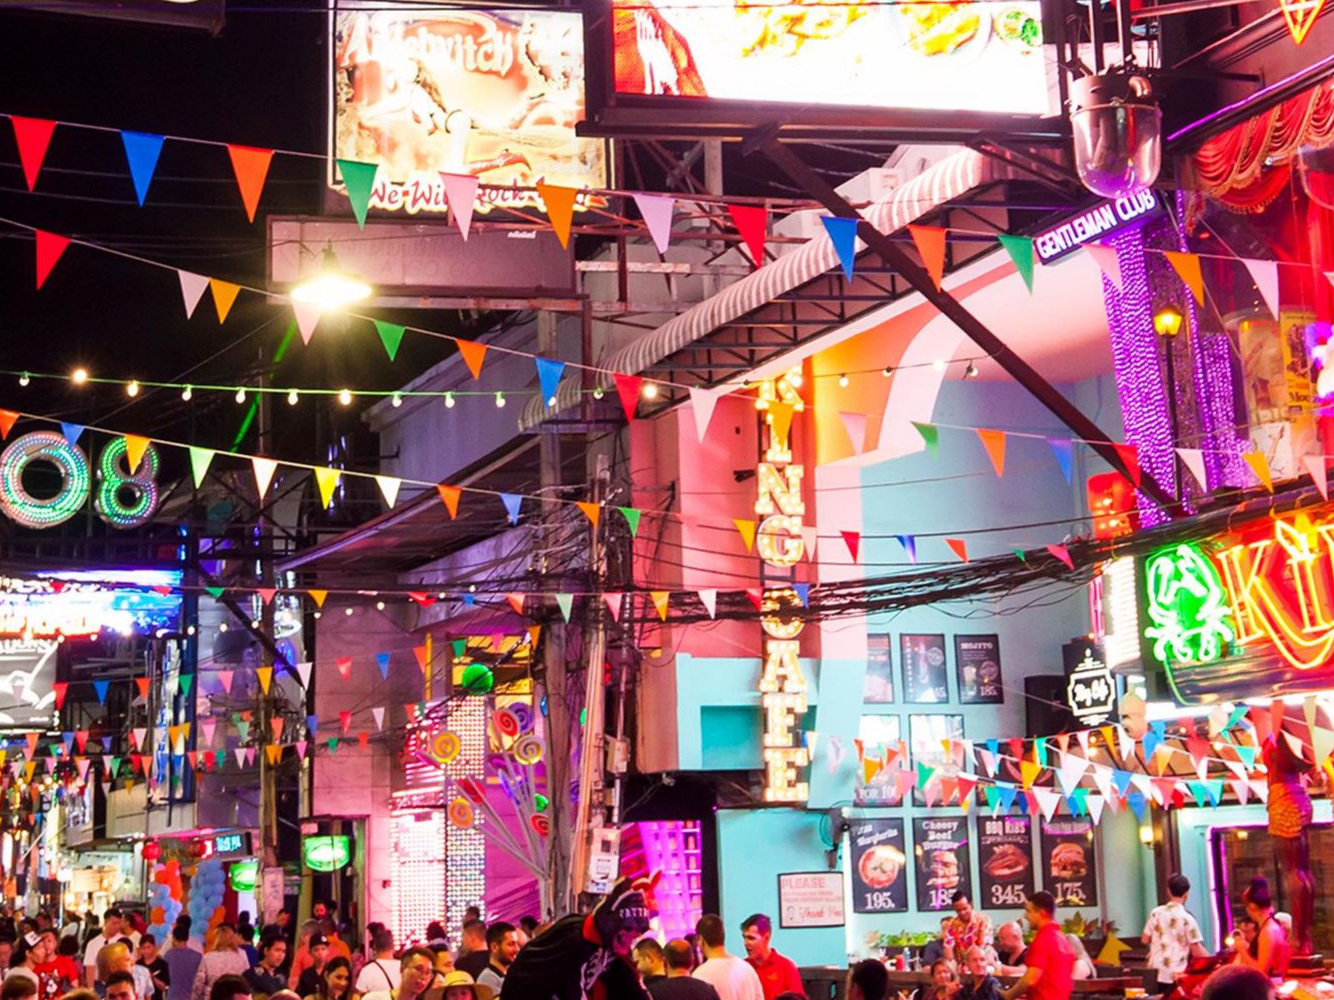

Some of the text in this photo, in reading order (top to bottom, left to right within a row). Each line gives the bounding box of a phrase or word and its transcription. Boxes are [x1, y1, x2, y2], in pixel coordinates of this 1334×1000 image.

[1035, 189, 1157, 260] GENTLEMAN CLUB
[985, 821, 1003, 835] BBQ
[927, 830, 953, 841] Beef
